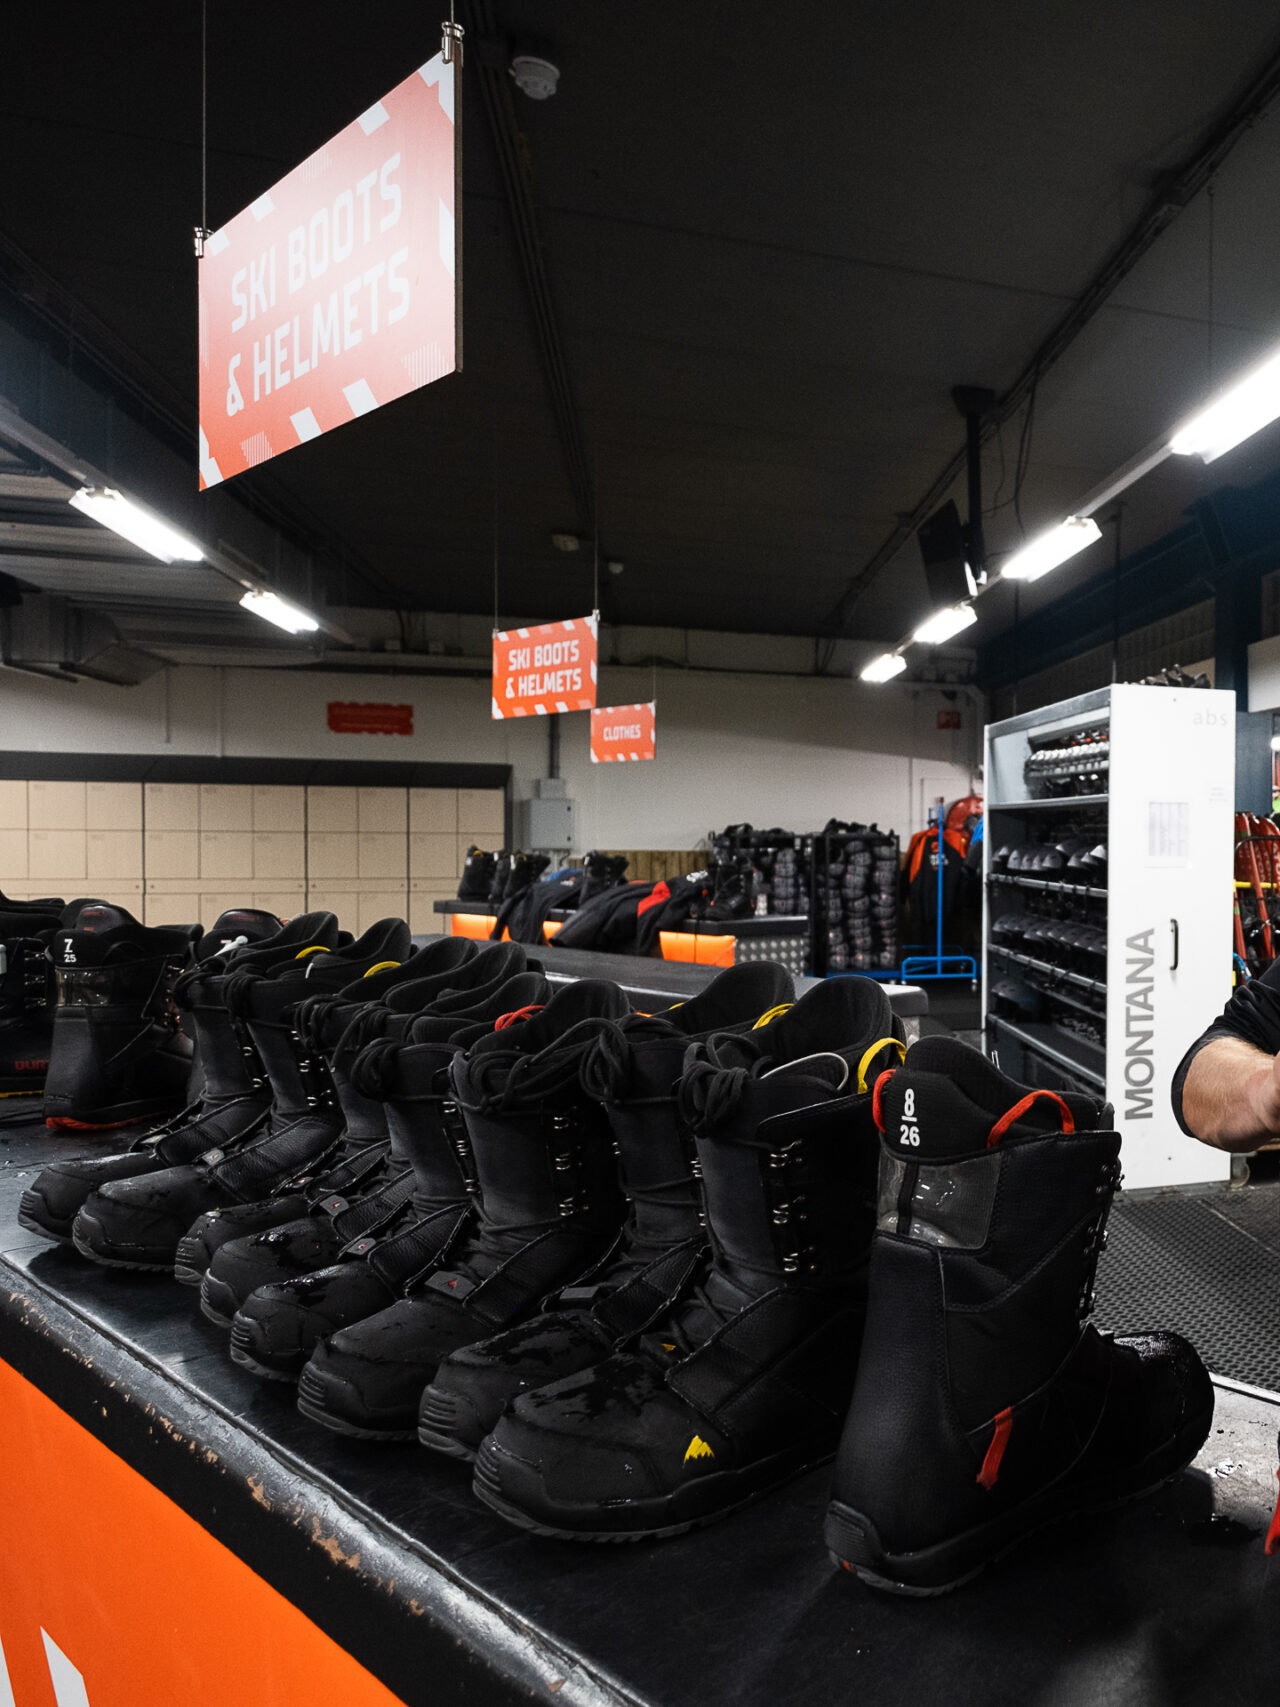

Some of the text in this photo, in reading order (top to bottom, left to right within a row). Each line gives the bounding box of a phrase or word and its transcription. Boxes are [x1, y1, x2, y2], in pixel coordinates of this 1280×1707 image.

[231, 152, 401, 333] SKI BOOTS
[226, 246, 410, 417] & HELMETS
[508, 640, 580, 671] SKI BOOTS
[505, 668, 582, 699] & HELMETS
[1193, 707, 1228, 727] abs
[603, 724, 641, 741] CLOTHES
[64, 938, 74, 952] 7
[64, 954, 77, 963] 25
[1124, 928, 1155, 1120] MONTANA
[904, 1088, 915, 1117] 8
[900, 1124, 920, 1147] 26
